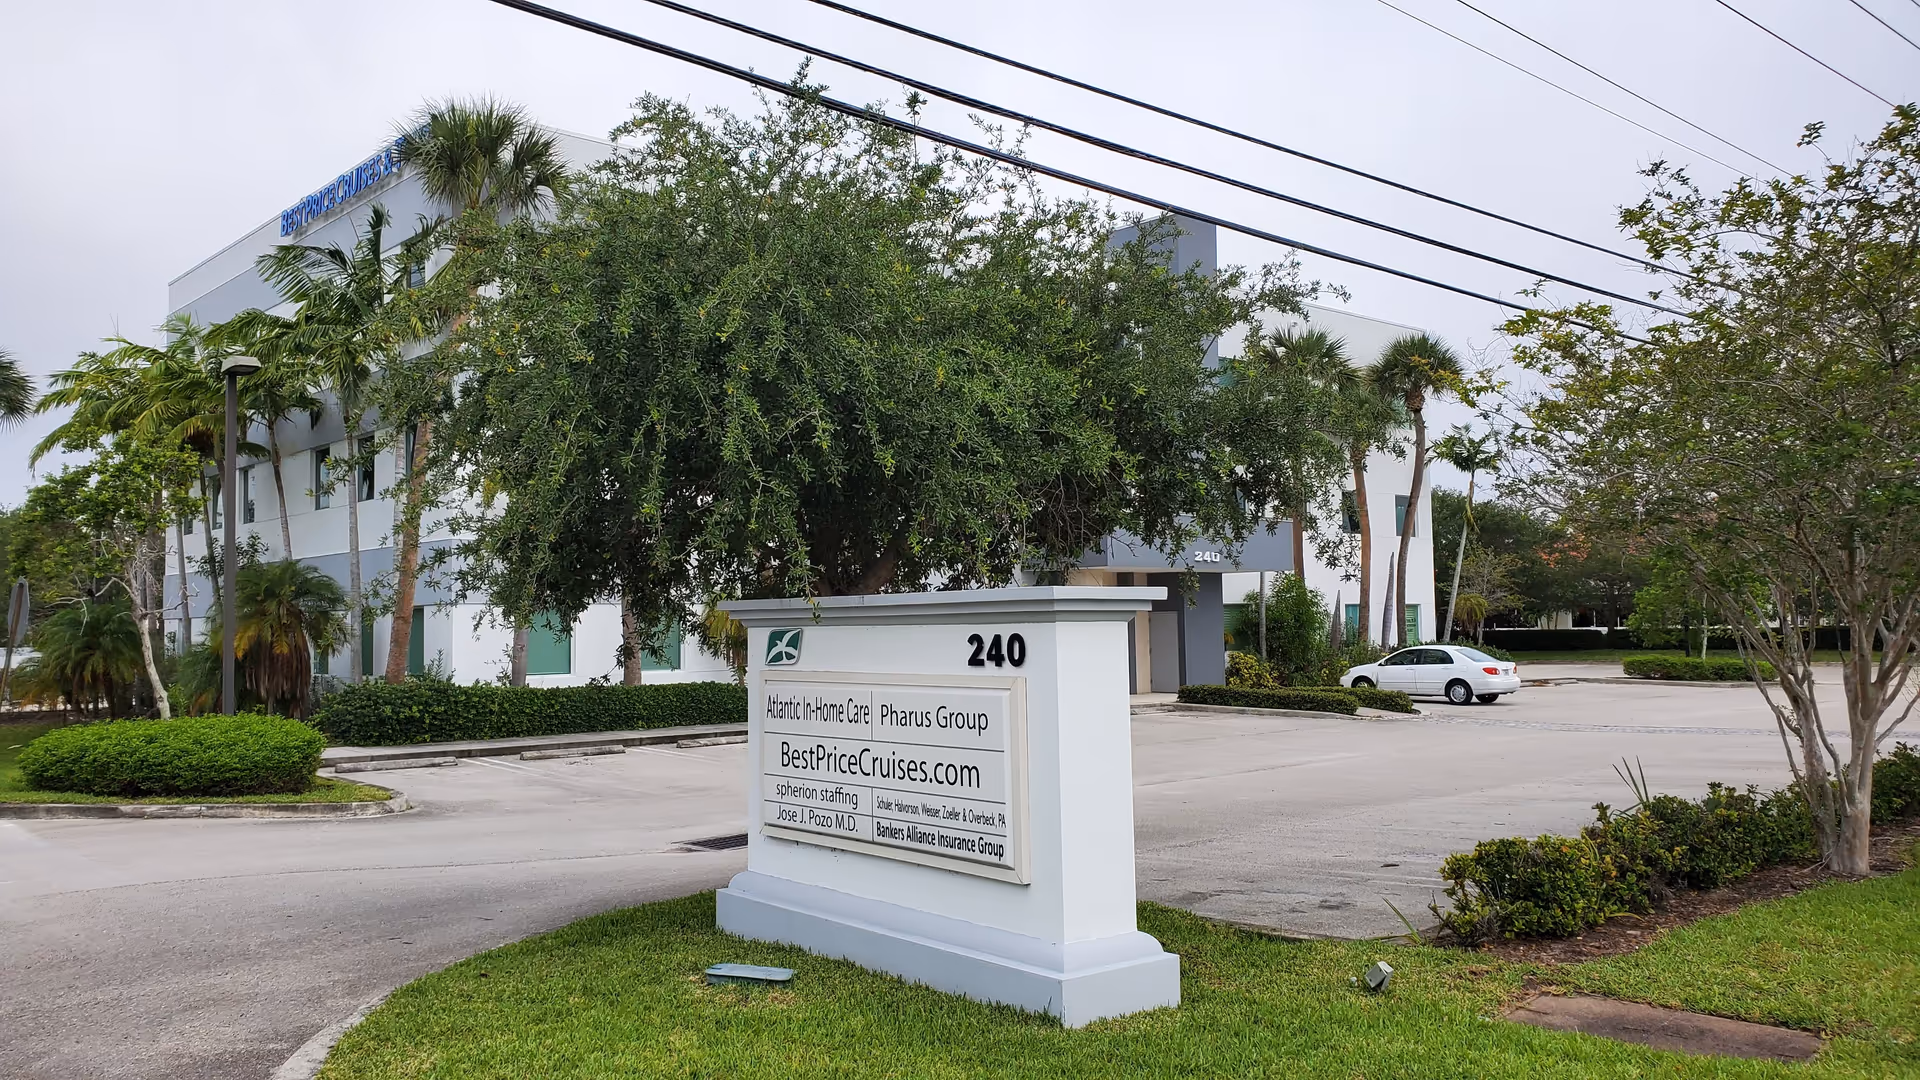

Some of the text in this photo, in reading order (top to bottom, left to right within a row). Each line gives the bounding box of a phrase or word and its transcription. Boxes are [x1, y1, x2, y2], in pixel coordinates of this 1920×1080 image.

[335, 154, 382, 204] CRUISES
[383, 149, 392, 176] &
[1194, 551, 1220, 562] 240
[967, 633, 1026, 667] 240
[766, 693, 870, 725] Atlantic In-Home Care
[880, 703, 989, 737] Pharus Group
[781, 741, 981, 789] BestPriceCruises.com
[776, 780, 859, 810] spherion staffing
[877, 795, 894, 813] Schuler,
[895, 798, 920, 817] Halvorson,
[942, 805, 961, 821] Zoeller
[962, 808, 968, 823] &
[968, 808, 998, 829] Overbeck,
[998, 813, 1007, 829] PA
[777, 805, 859, 833] Jose J. Pozo M.D.
[876, 821, 1005, 862] Bankers Alliance Insurance Group
